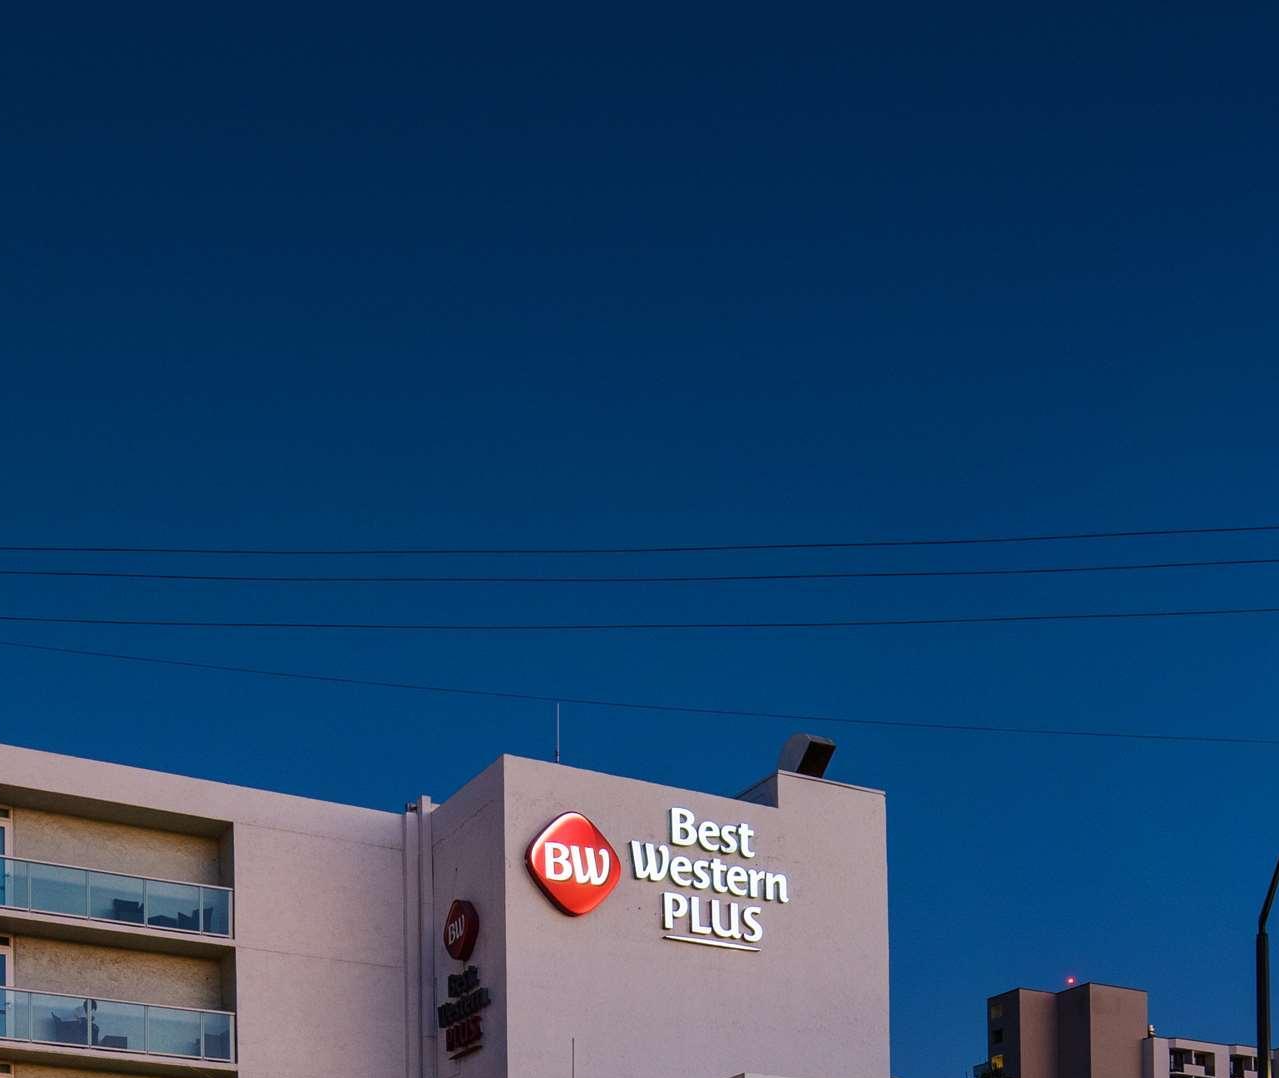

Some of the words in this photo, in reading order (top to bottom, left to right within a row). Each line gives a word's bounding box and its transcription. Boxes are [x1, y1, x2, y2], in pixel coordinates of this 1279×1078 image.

[670, 807, 755, 858] Best
[544, 842, 610, 886] BW
[630, 840, 789, 903] Western
[447, 914, 466, 945] BW
[662, 892, 763, 942] PLUS
